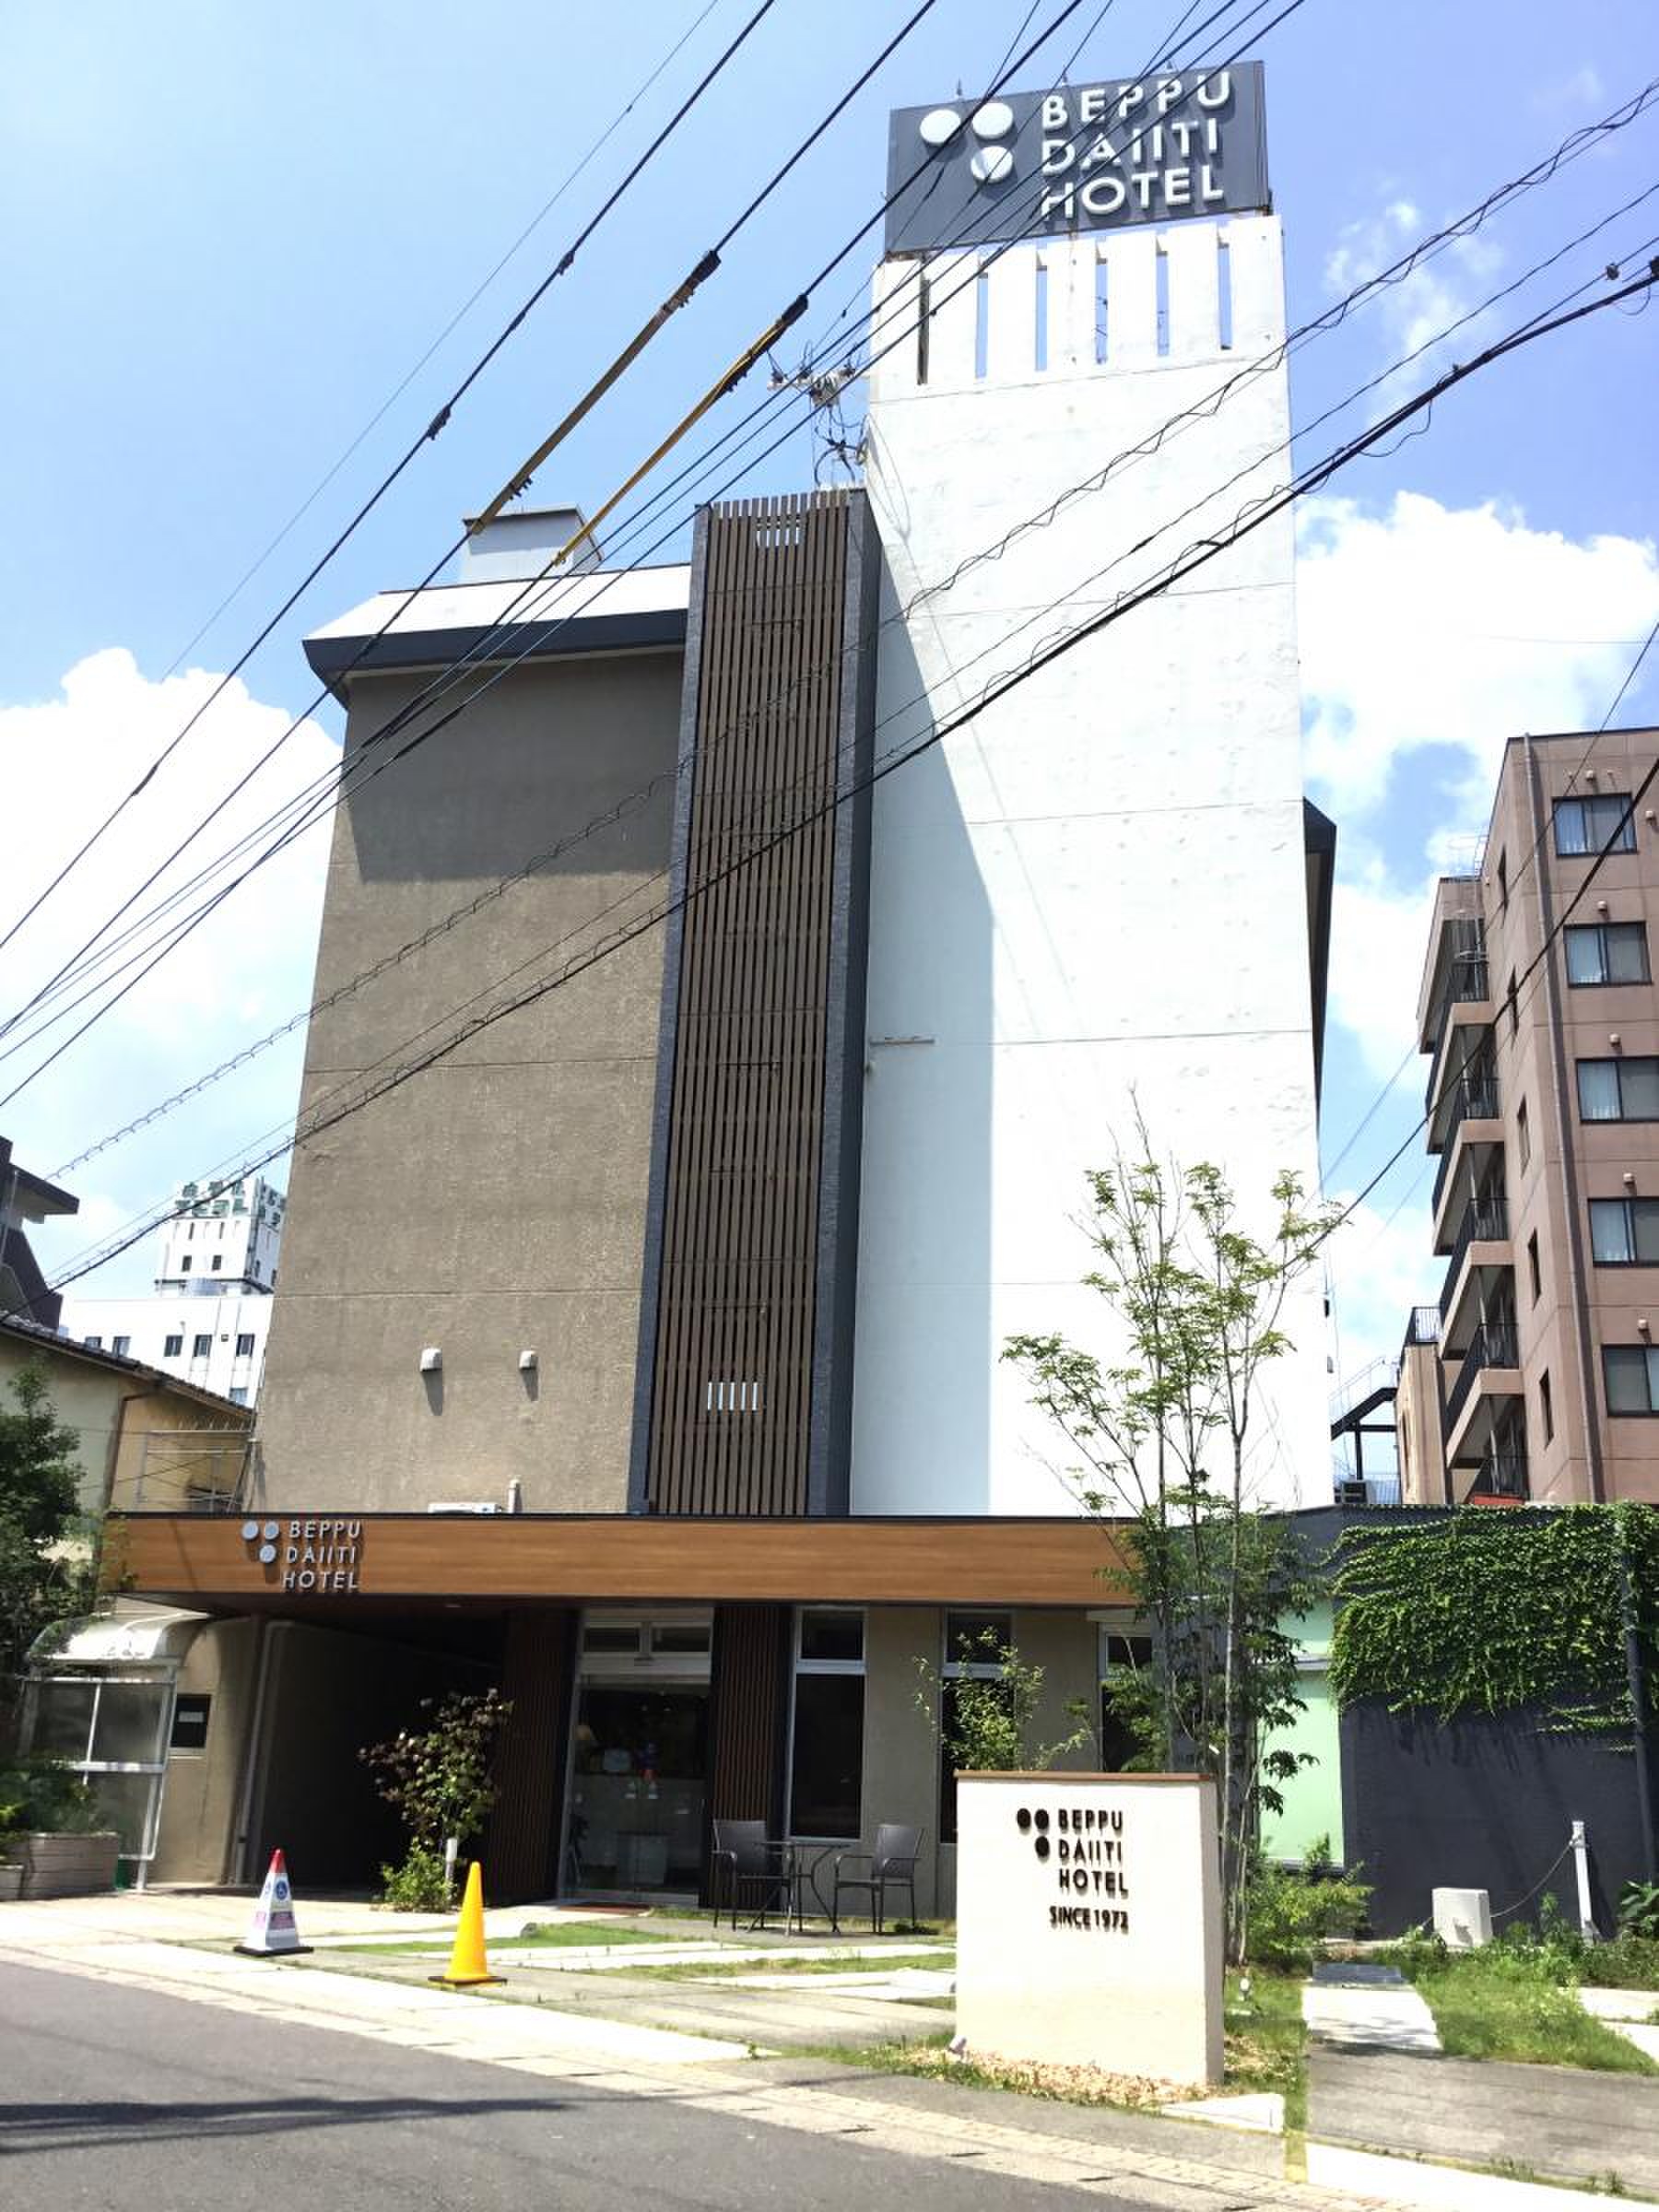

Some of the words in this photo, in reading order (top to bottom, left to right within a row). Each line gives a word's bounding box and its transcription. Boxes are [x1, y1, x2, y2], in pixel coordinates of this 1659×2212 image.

[1041, 71, 1231, 132] BEPPU
[1041, 118, 1219, 176] DAIITI
[1040, 164, 1225, 220] HOTEL
[288, 1521, 361, 1539] BEPPU
[287, 1546, 356, 1564] DAIITI
[282, 1570, 359, 1589] HOTEL
[1057, 1807, 1124, 1833] BEPPU
[1057, 1837, 1123, 1865] DAIITI
[1059, 1867, 1129, 1898] HOTEL
[1049, 1905, 1091, 1929] SINCE
